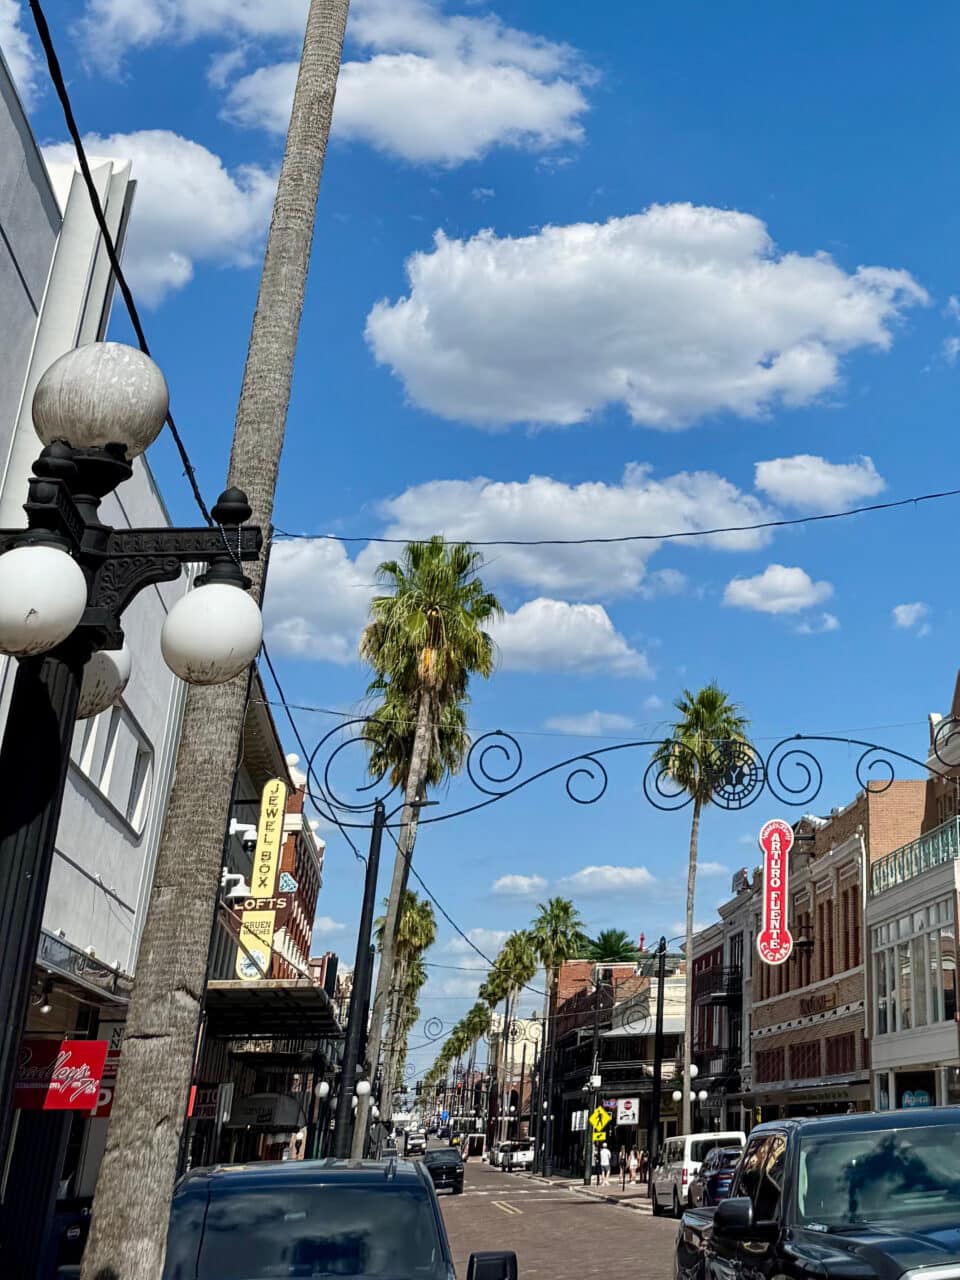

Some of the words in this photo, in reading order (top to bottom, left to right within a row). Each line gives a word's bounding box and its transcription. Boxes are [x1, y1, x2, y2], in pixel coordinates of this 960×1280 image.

[263, 782, 280, 846] JEWEL
[258, 850, 272, 889] BOX
[769, 832, 782, 888] ARTURO
[769, 890, 781, 950] FUENTE
[760, 941, 791, 961] CIGARS
